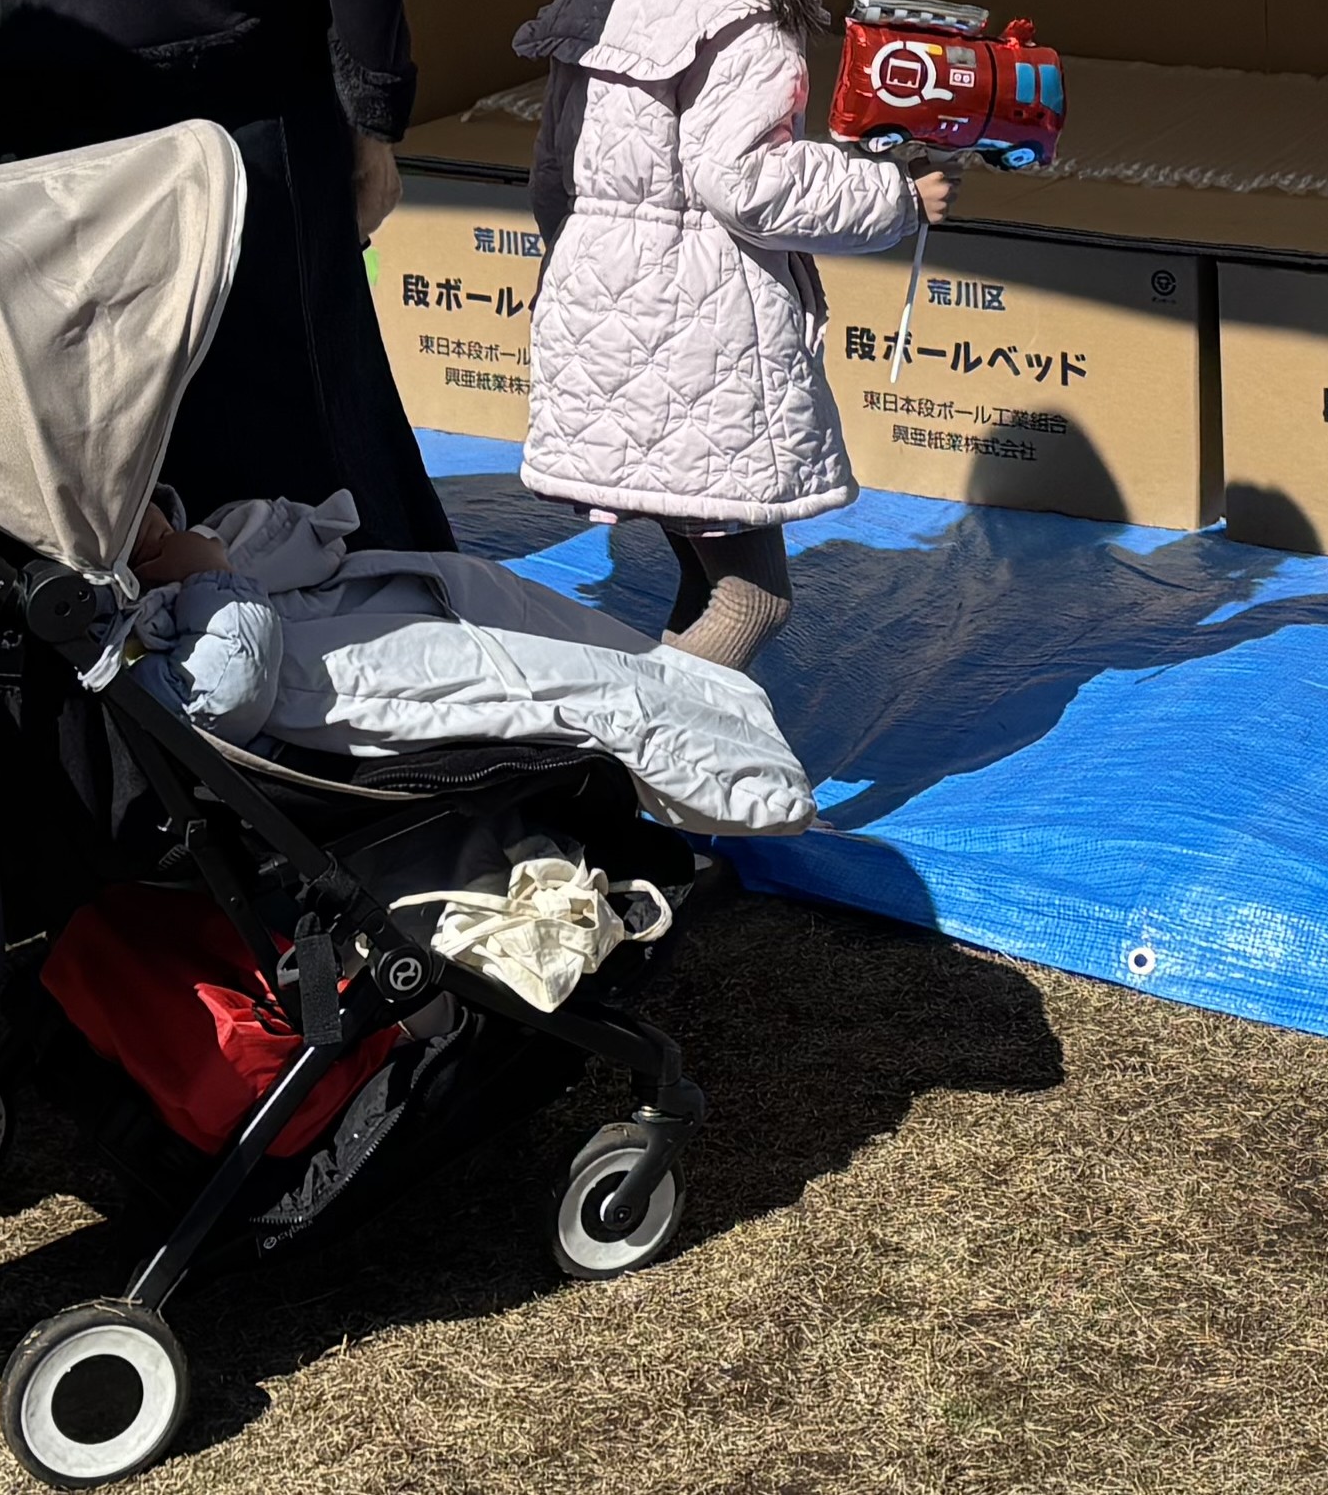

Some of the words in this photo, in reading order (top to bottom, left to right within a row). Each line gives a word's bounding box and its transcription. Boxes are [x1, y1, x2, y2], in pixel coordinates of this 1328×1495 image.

[473, 226, 543, 257] 荒川区
[402, 274, 533, 318] 段ボール
[927, 278, 1006, 311] 荒川区
[845, 326, 1087, 386] 段ボールベッド
[863, 390, 1069, 435] 東日本段ボール工業組合
